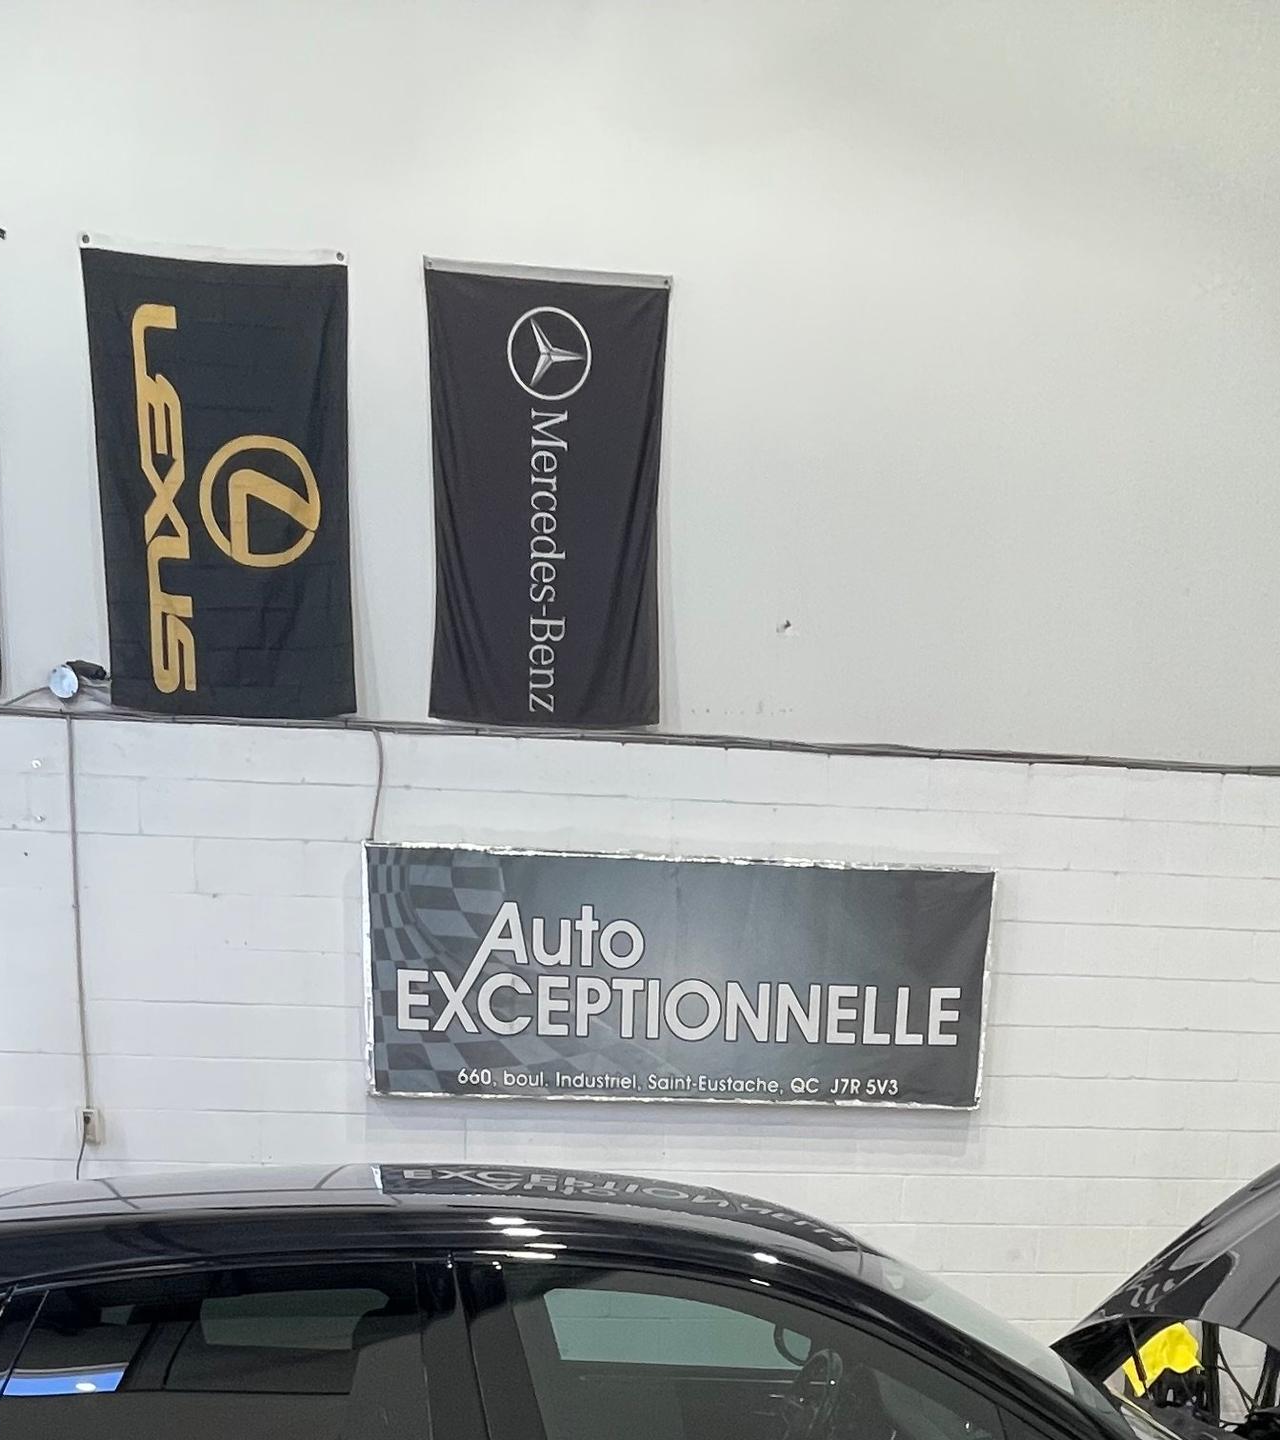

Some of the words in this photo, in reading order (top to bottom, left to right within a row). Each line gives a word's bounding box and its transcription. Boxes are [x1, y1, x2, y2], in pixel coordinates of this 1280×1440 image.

[131, 302, 198, 695] LEXUS
[528, 408, 569, 713] Mercedes-Benz
[460, 899, 646, 972] Auto
[395, 966, 963, 1047] EXCEPTIONNELLE
[456, 1067, 498, 1088] 660,
[503, 1069, 549, 1088] boul.
[555, 1071, 642, 1092] Industriel,
[647, 1073, 784, 1095] Saint-Eustache,
[790, 1077, 820, 1094] QC
[829, 1078, 862, 1095] J7R
[865, 1079, 900, 1096] 5V3
